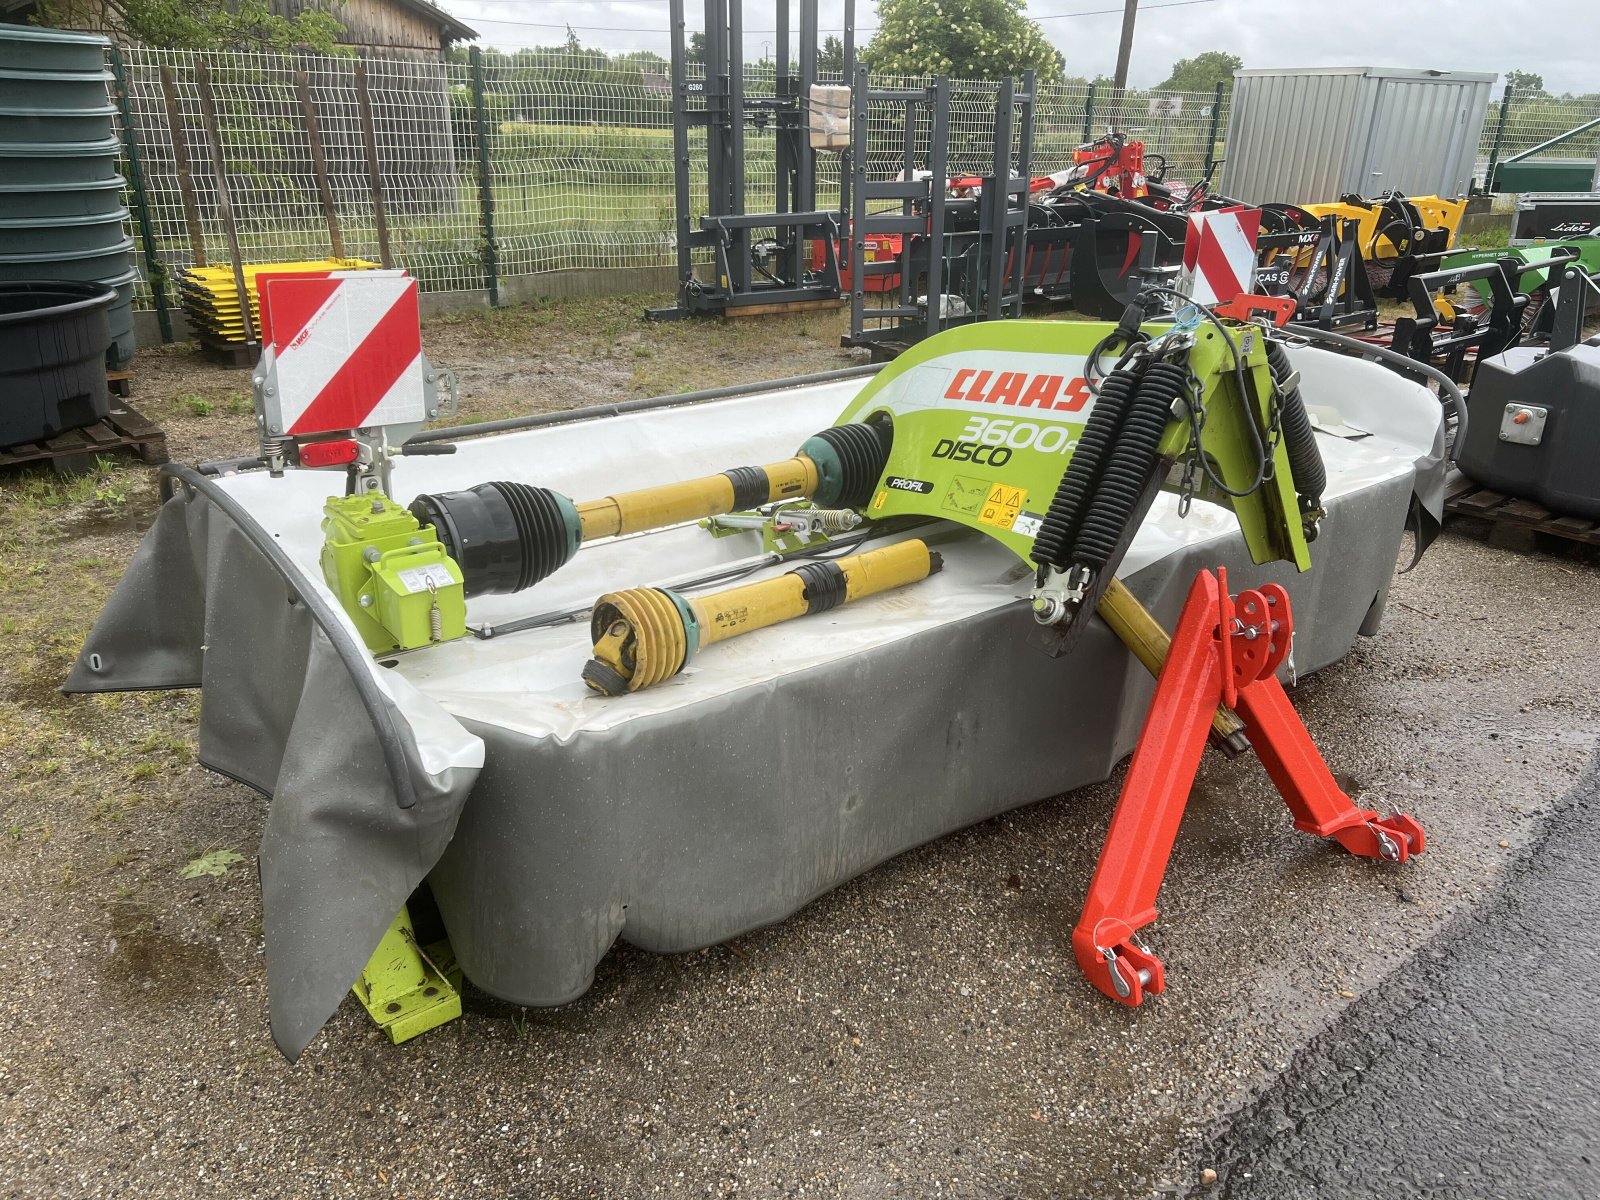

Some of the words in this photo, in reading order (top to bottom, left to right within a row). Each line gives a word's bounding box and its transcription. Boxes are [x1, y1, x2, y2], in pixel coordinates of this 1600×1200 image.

[944, 368, 1098, 412] CLAAS
[931, 439, 1012, 467] DISCO
[890, 478, 924, 492] PROFIL
